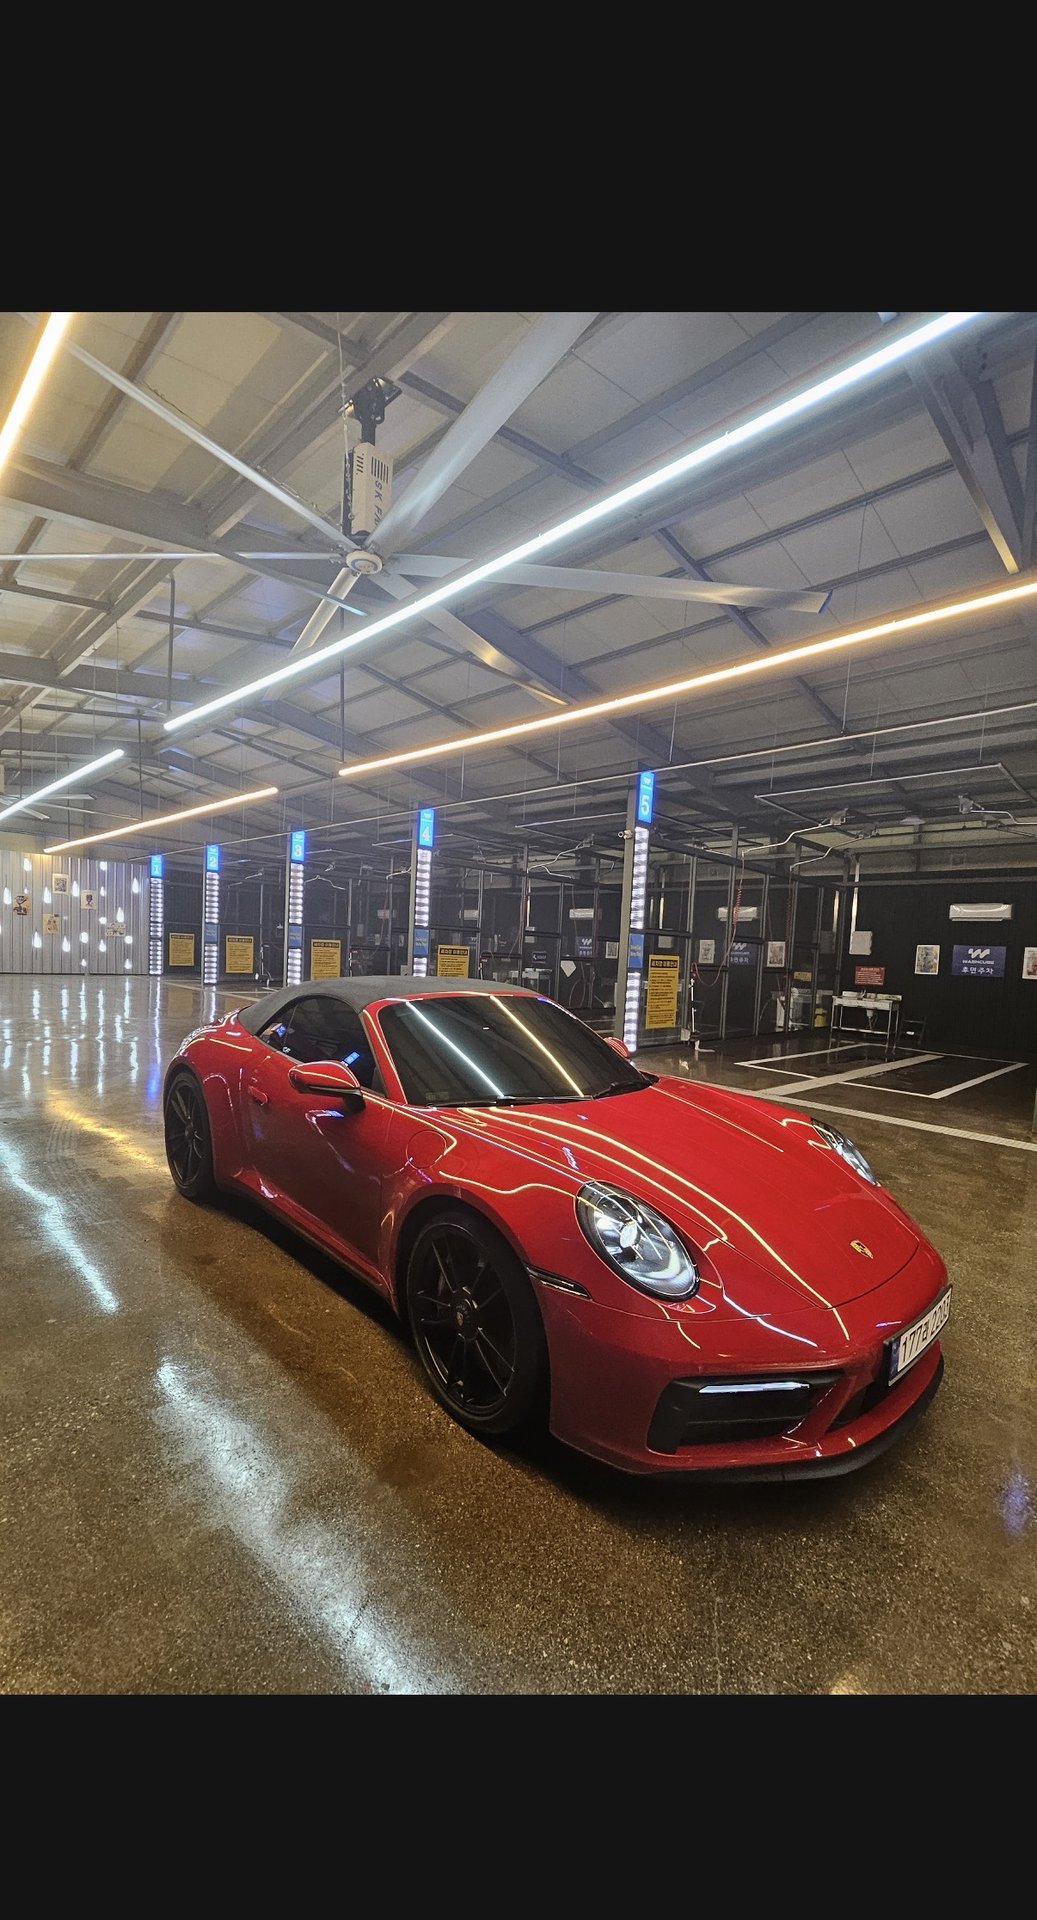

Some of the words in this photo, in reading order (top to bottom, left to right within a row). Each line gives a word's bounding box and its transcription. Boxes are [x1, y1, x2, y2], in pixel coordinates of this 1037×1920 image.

[375, 480, 383, 502] SK
[641, 794, 650, 815] 5
[422, 825, 430, 842] 4
[294, 844, 302, 856] 3
[210, 857, 216, 866] 2
